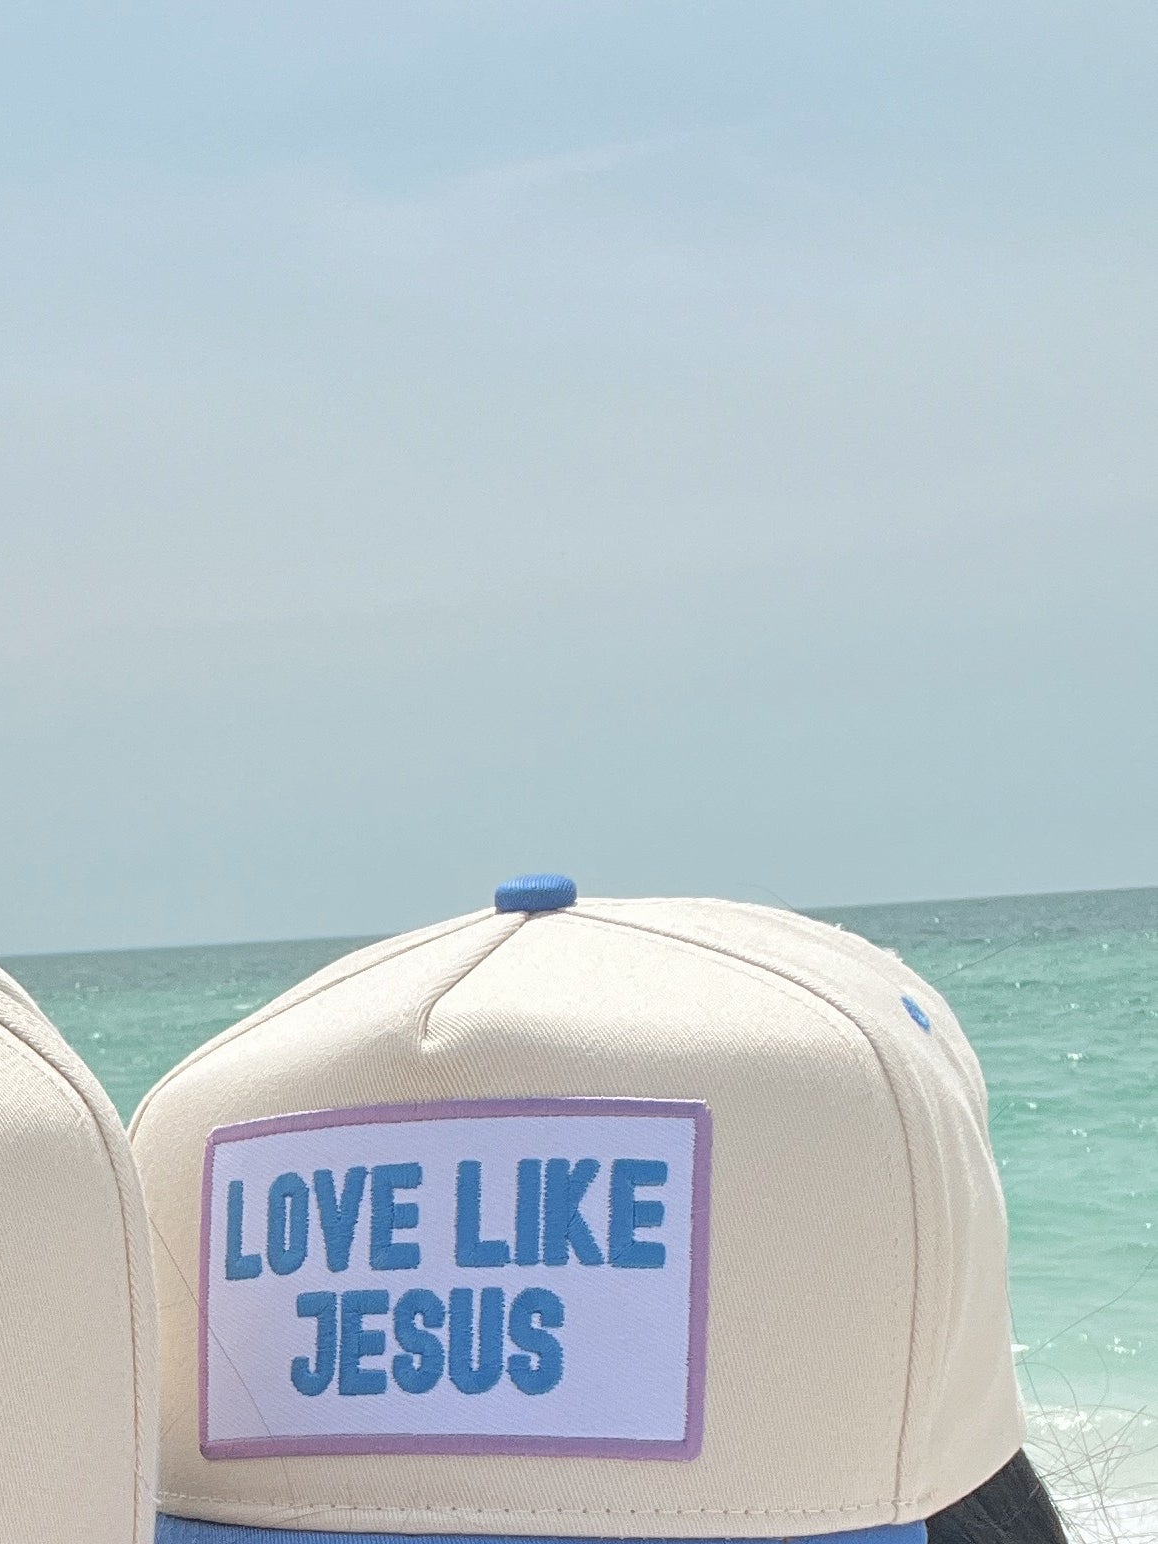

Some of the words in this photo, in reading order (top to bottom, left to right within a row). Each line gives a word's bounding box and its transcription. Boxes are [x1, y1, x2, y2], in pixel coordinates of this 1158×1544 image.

[225, 1162, 422, 1280] LOVE
[455, 1158, 668, 1269] LIKE
[290, 1287, 564, 1396] JESUS
